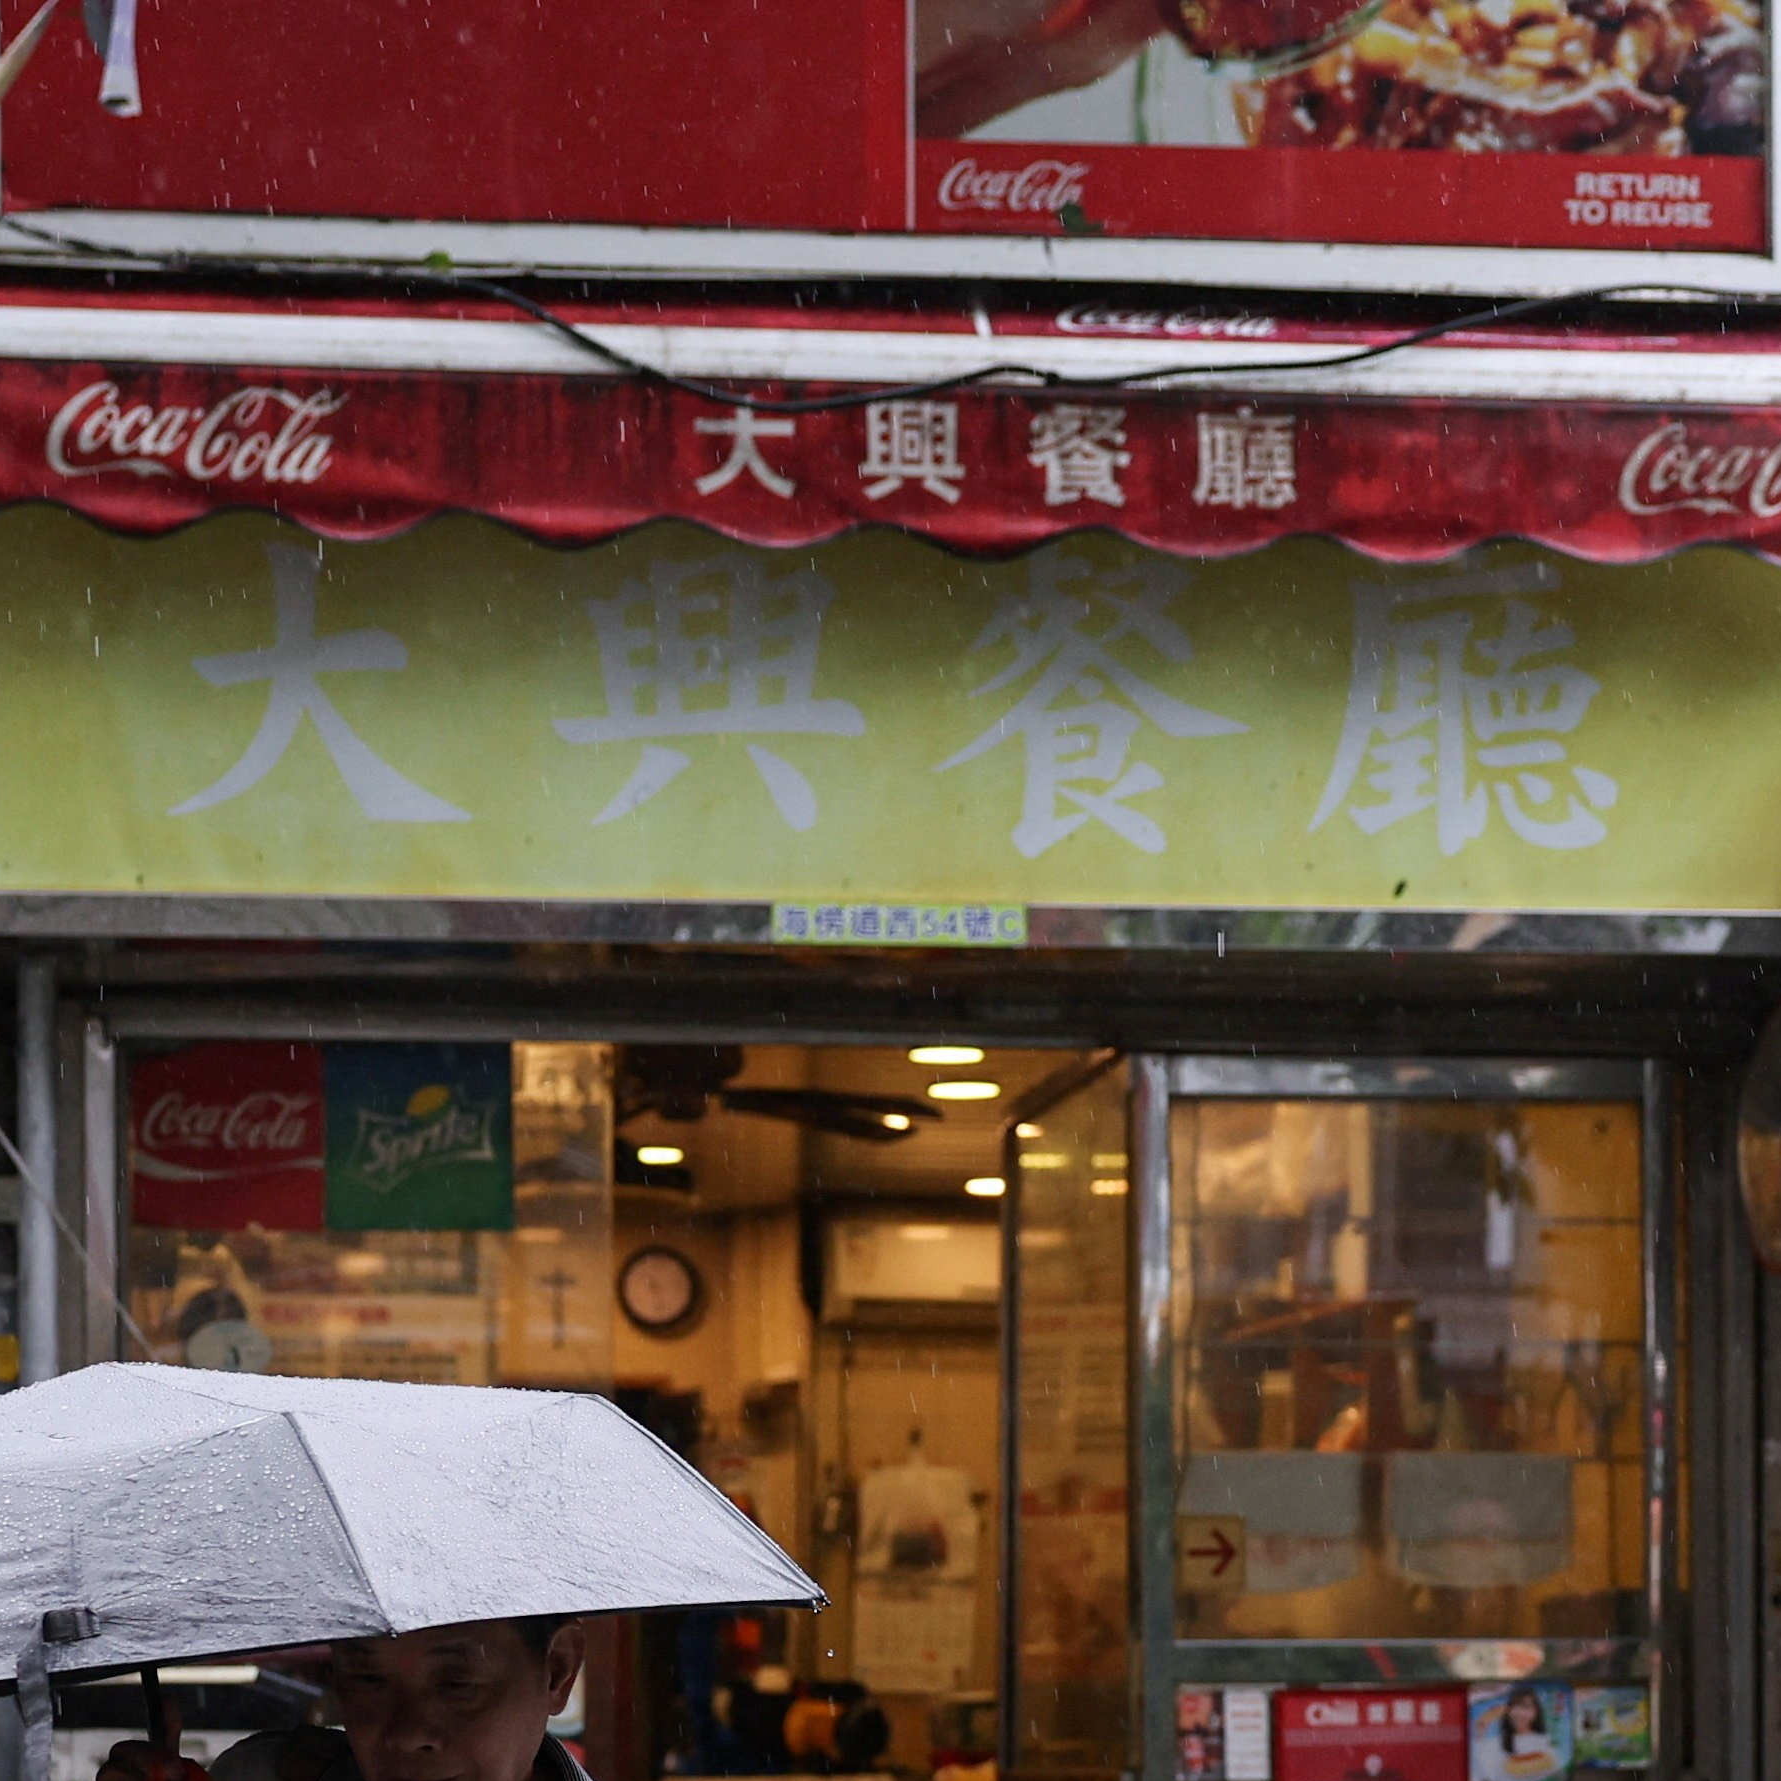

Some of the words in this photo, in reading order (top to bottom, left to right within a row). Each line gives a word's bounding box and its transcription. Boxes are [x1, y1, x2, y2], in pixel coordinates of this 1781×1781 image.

[938, 158, 1091, 211] Coca-Cola
[1564, 200, 1607, 225] TO
[1611, 201, 1713, 228] REUSE
[1574, 172, 1701, 198] RETURN
[45, 380, 349, 483] Coca-Cola
[694, 397, 1298, 512] 大興餐廳
[167, 545, 1618, 860] 大興餐廳
[141, 1092, 318, 1150] Coca-Cola
[366, 1110, 487, 1178] Sprite
